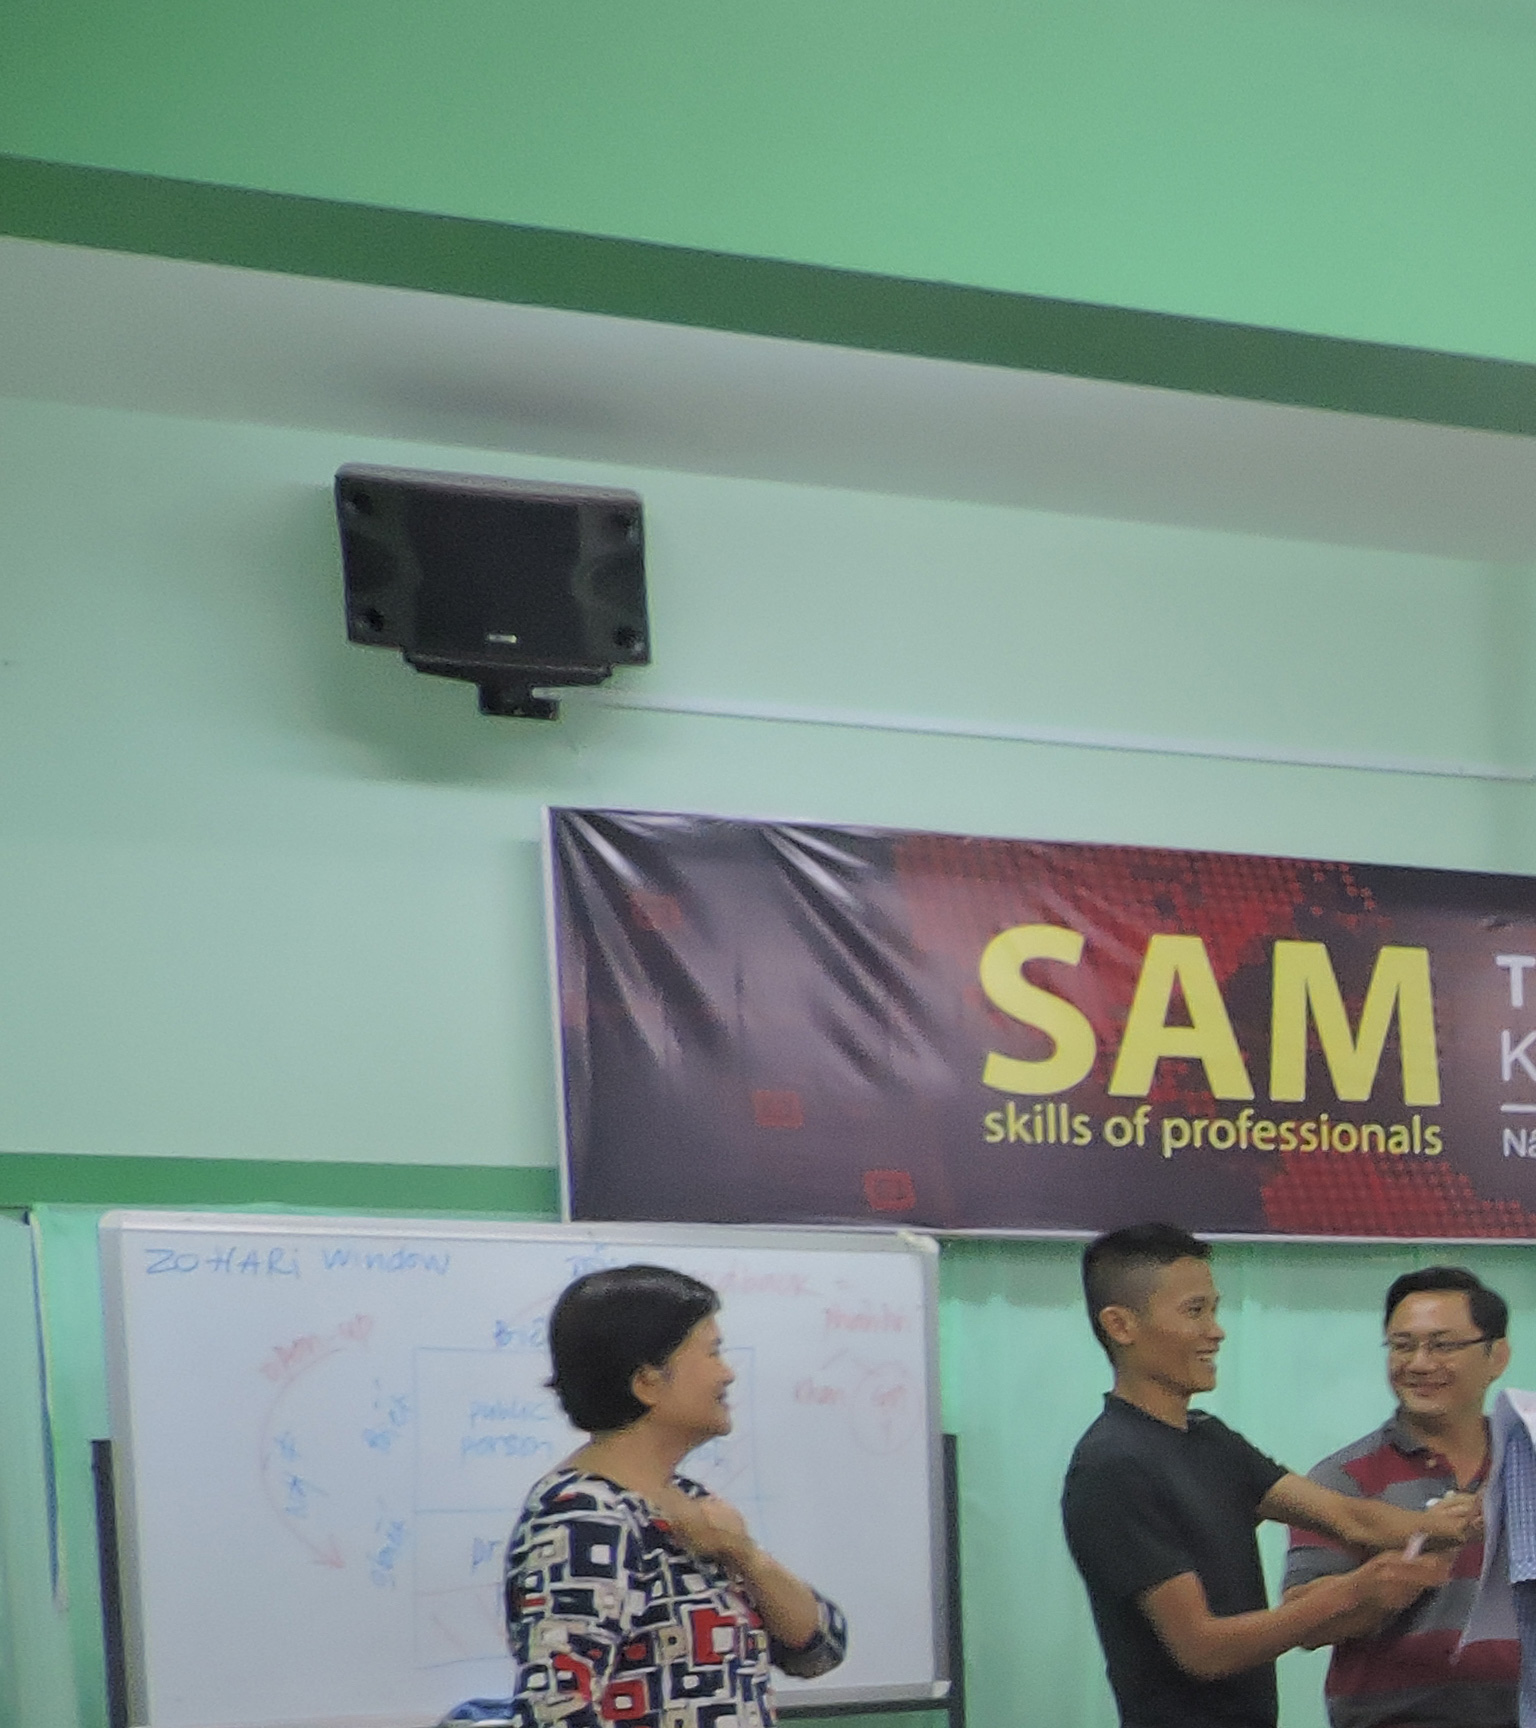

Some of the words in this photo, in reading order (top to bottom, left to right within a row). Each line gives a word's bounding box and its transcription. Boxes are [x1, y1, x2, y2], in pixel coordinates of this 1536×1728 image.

[979, 923, 1441, 1106] SAM
[984, 1103, 1093, 1146] skills
[1104, 1105, 1153, 1147] of
[1161, 1108, 1443, 1159] professionals
